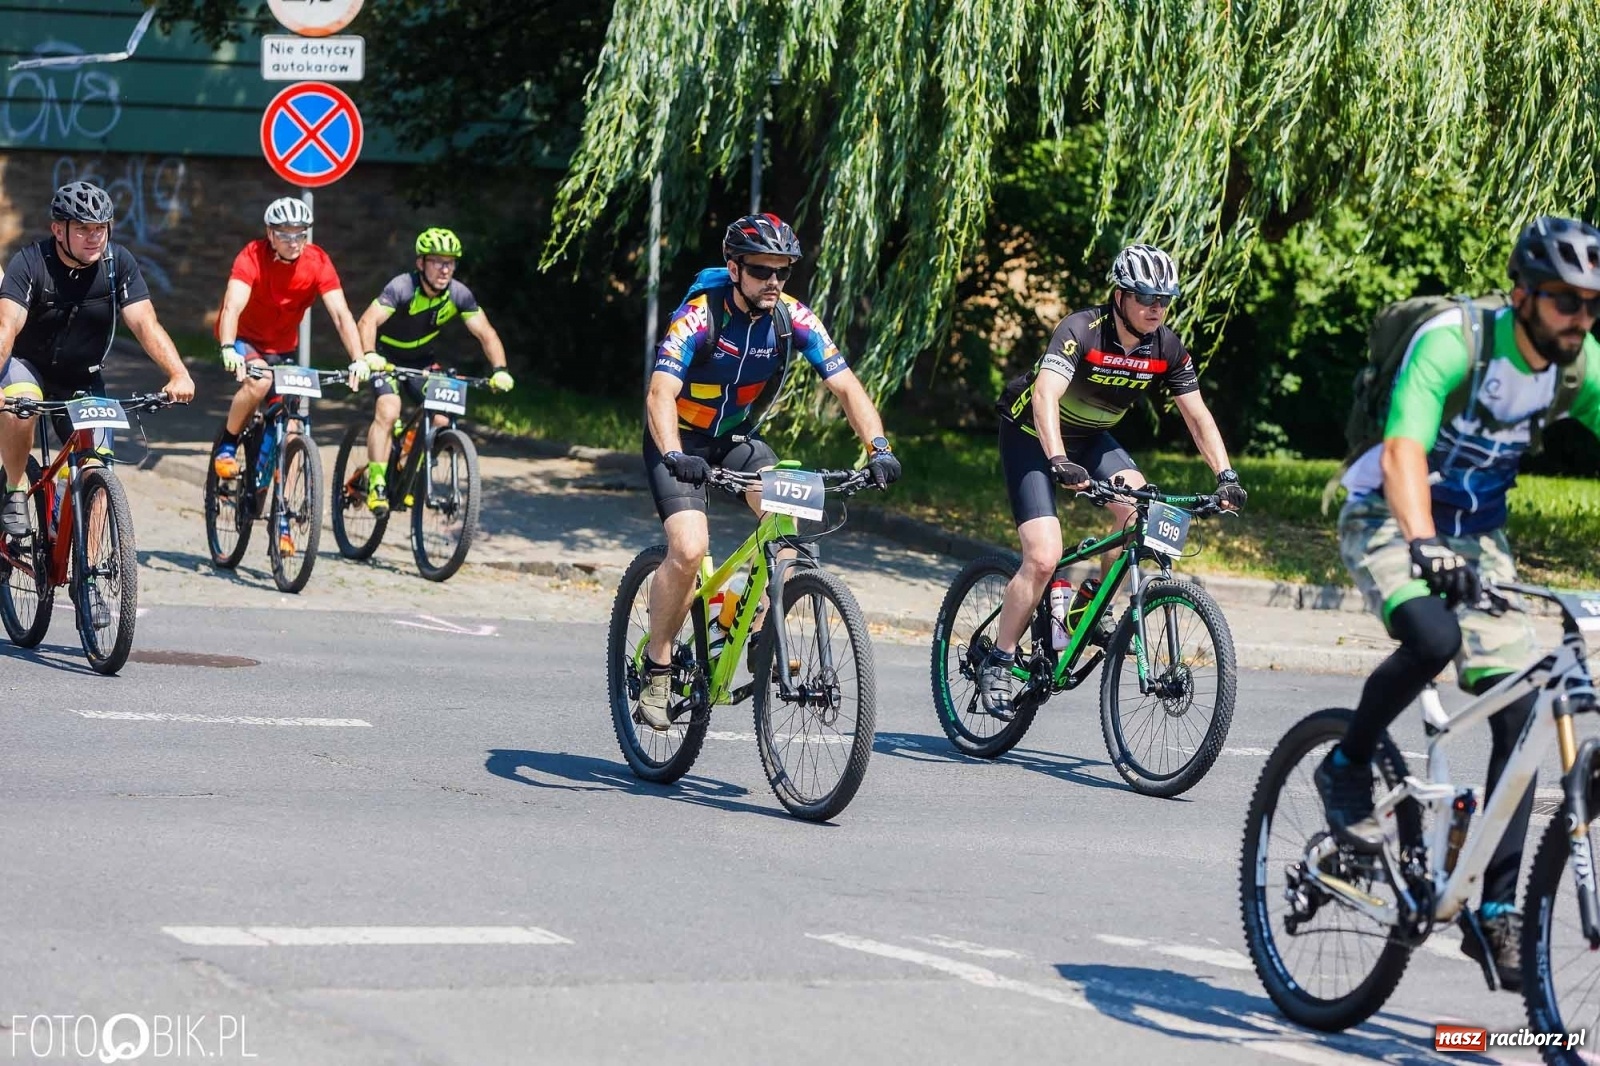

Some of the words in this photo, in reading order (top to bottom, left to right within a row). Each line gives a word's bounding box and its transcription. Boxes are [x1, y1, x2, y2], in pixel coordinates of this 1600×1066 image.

[270, 42, 294, 54] Nie
[301, 43, 355, 57] dotyczy
[1102, 355, 1150, 370] SRAM
[1087, 373, 1152, 390] SCOTT
[434, 387, 460, 403] 1473
[78, 406, 117, 419] 2030
[773, 480, 813, 501] 1757
[1158, 520, 1180, 542] 1919
